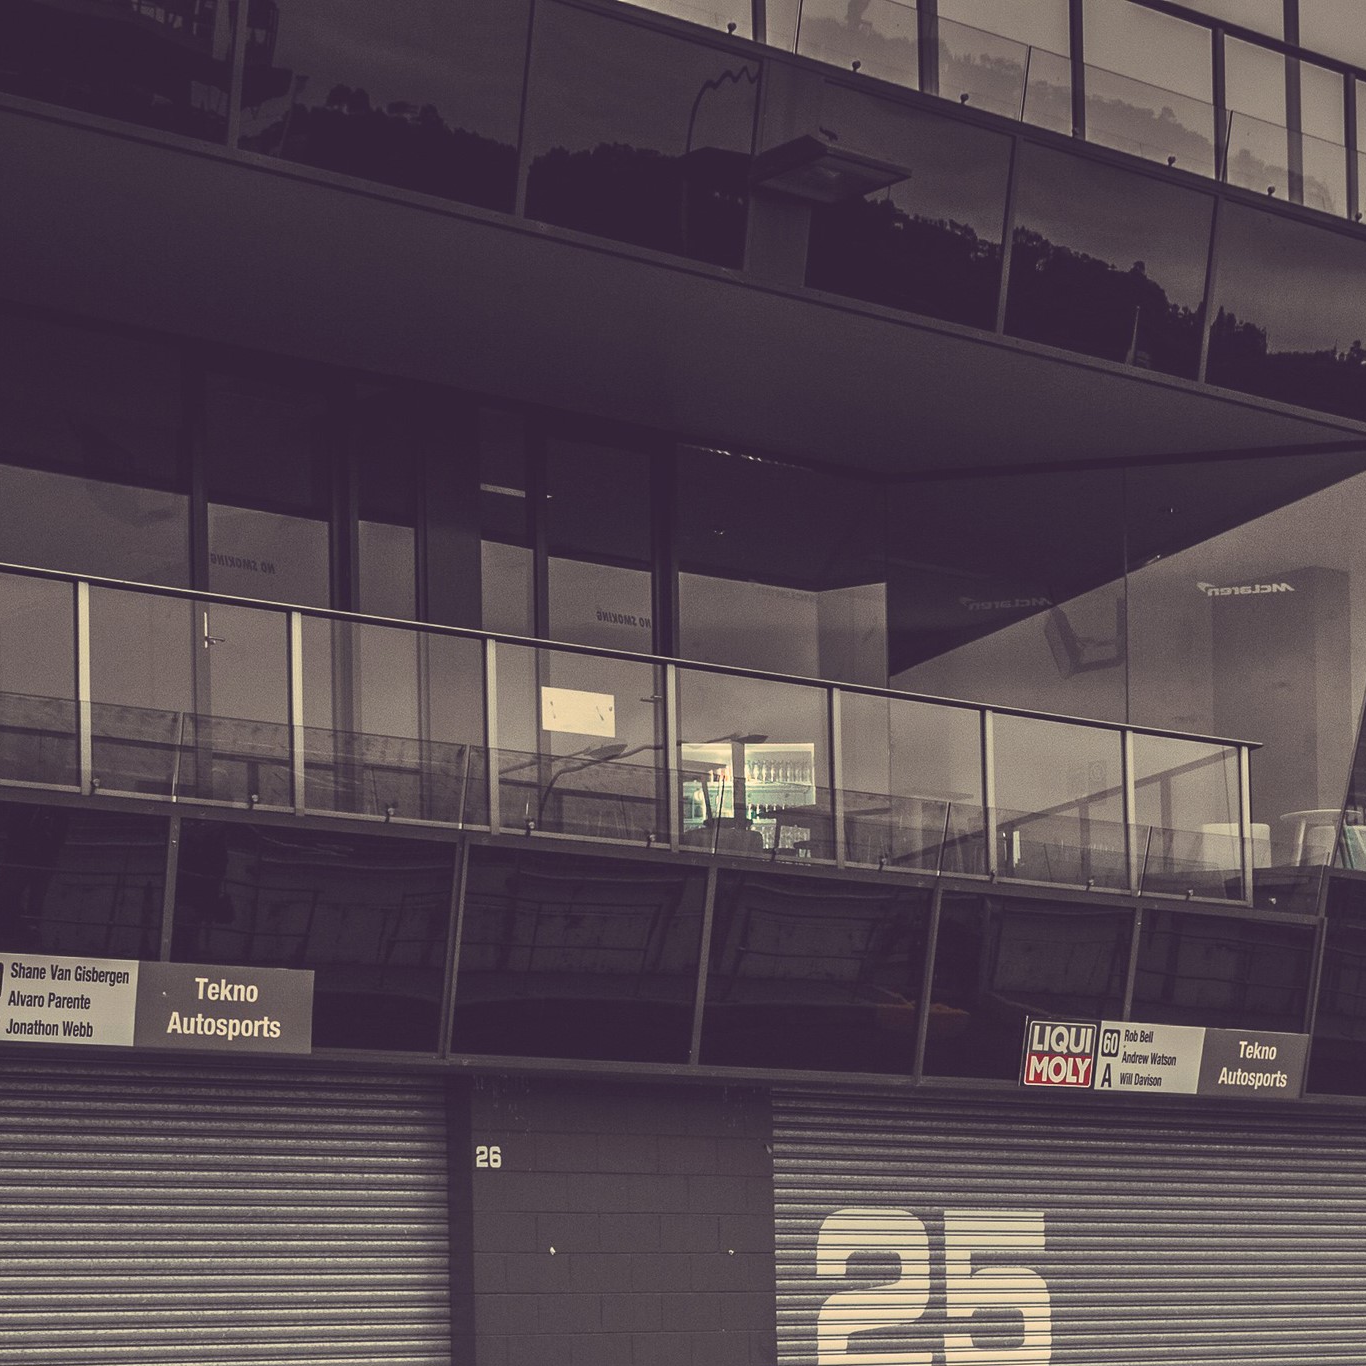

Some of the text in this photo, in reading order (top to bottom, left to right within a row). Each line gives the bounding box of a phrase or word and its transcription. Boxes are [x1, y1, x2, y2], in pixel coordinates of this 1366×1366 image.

[11, 962, 129, 986] Shane Van Gisbergen
[8, 991, 90, 1009] Alvaro Parente
[195, 977, 258, 1002] Tekno
[6, 1019, 93, 1037] Jonathon Webb
[166, 1011, 281, 1041] Autosports
[1124, 1030, 1153, 1043] Rob Bell
[1032, 1025, 1092, 1054] LIQUI
[1103, 1032, 1119, 1054] 60
[1239, 1041, 1277, 1060] Tekno
[1029, 1056, 1091, 1083] MOLY
[1122, 1051, 1176, 1066] Andrew Watson
[1101, 1063, 1112, 1088] A
[1120, 1072, 1162, 1087] Will Davison
[1218, 1067, 1288, 1090] Autosports
[476, 1145, 502, 1169] 26
